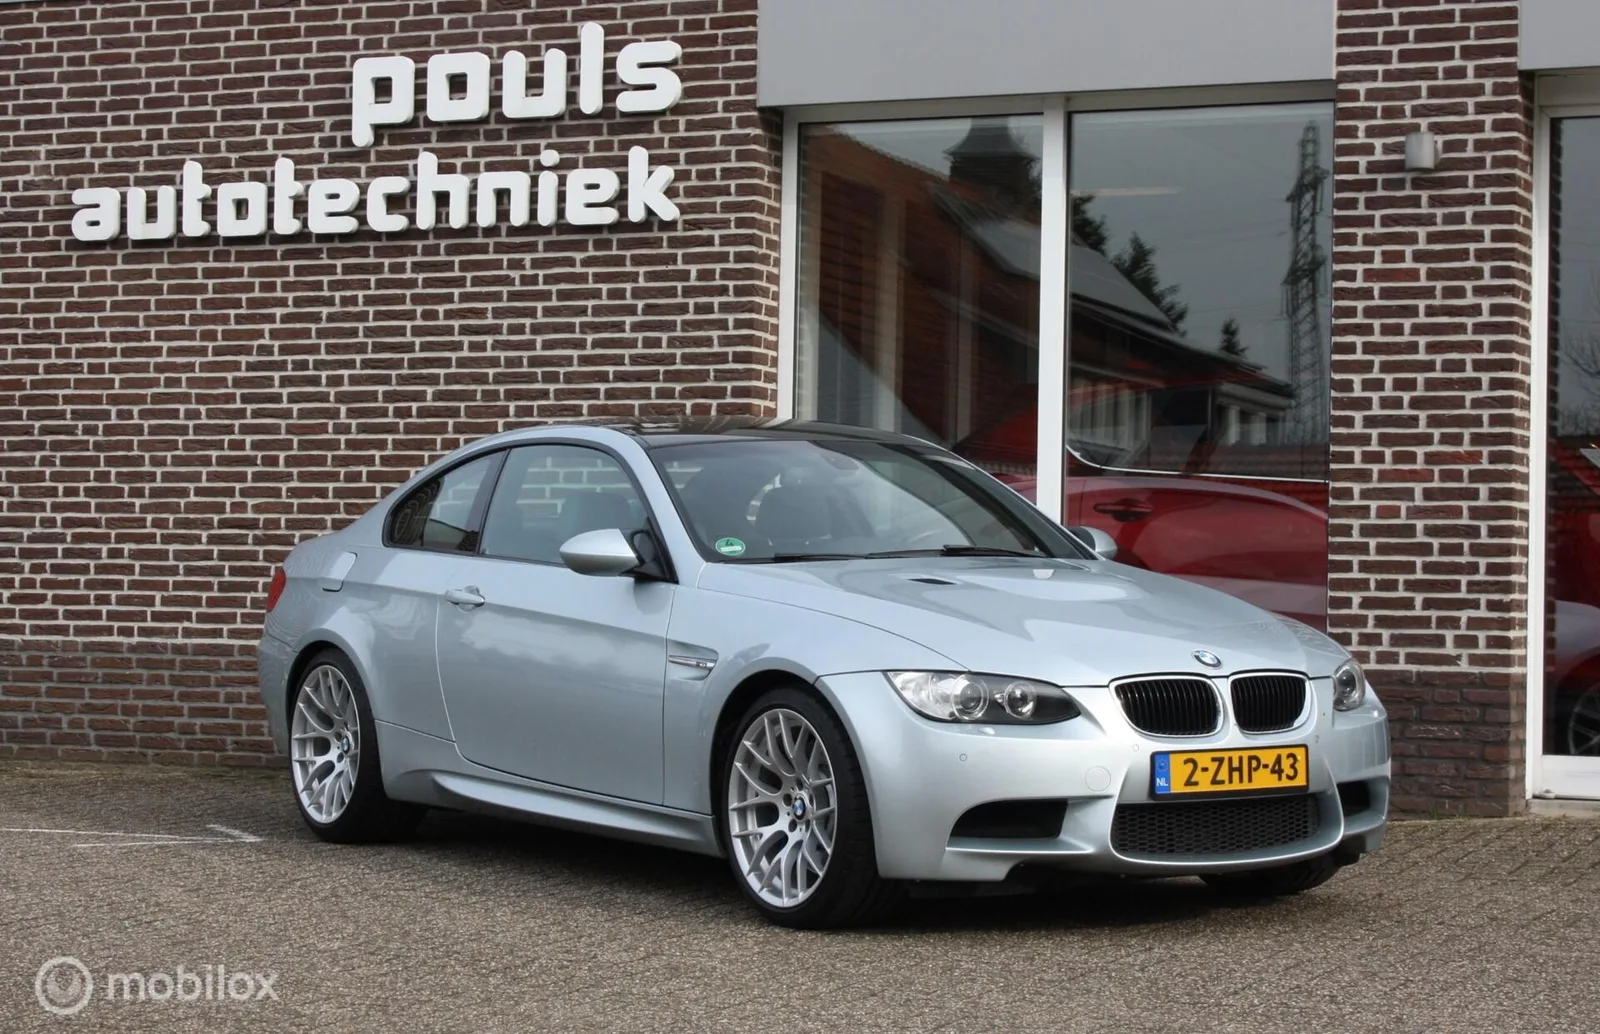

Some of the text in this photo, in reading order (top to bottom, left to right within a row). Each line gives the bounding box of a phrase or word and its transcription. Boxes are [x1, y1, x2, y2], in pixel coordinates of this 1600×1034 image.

[351, 22, 683, 147] pouls
[71, 145, 680, 241] autotechniek
[1156, 778, 1169, 787] NL
[1183, 753, 1299, 787] 2-ZHP-43
